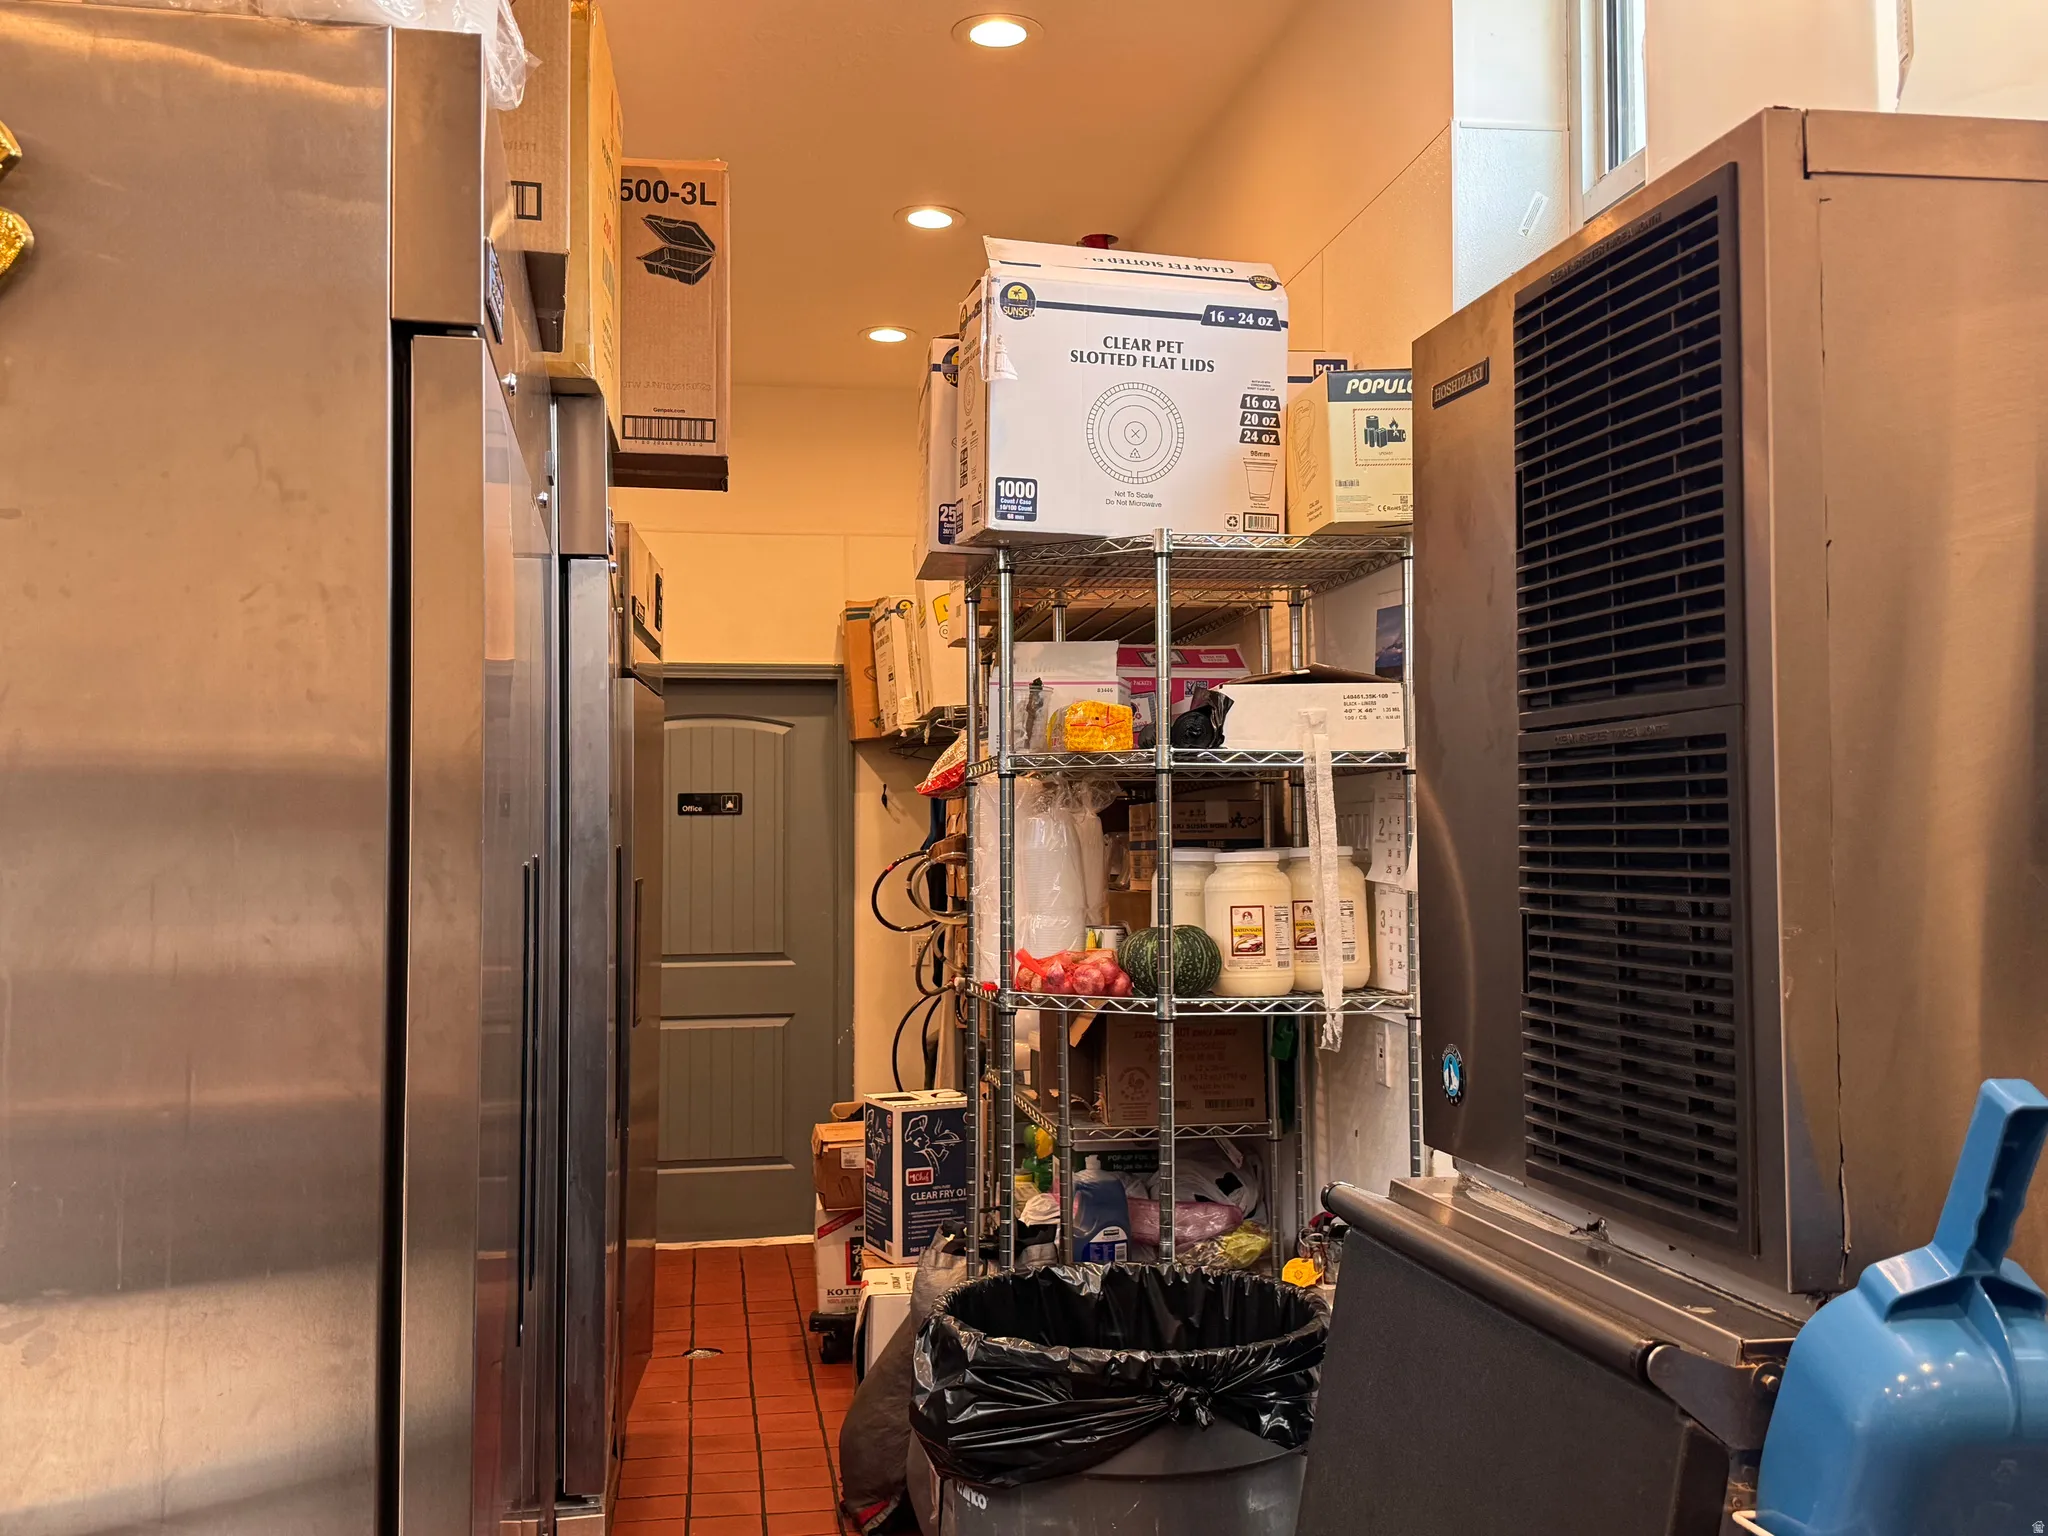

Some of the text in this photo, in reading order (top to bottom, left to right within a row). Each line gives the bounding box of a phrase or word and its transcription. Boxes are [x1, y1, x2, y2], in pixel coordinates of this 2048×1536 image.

[620, 178, 717, 206] 500-3L
[1002, 306, 1033, 318] SUNSET
[1210, 311, 1225, 323] 16
[1238, 312, 1254, 325] 24
[1257, 316, 1274, 327] oz
[1103, 336, 1184, 354] CLEAR PET
[1070, 349, 1215, 373] SLOTTED FLAT LIDS
[1434, 367, 1484, 402] HOSHIZAKI
[1245, 396, 1276, 410] 16 oz
[1244, 413, 1276, 427] 20 oz
[1244, 430, 1276, 443] 24 oz
[998, 480, 1035, 499] 1000
[1136, 492, 1154, 500] Scale
[940, 506, 956, 522] 25
[1378, 818, 1385, 836] 2
[1380, 910, 1386, 928] 3
[910, 1191, 938, 1201] CLEAR
[939, 1189, 955, 1199] FRY
[956, 1188, 967, 1197] OI
